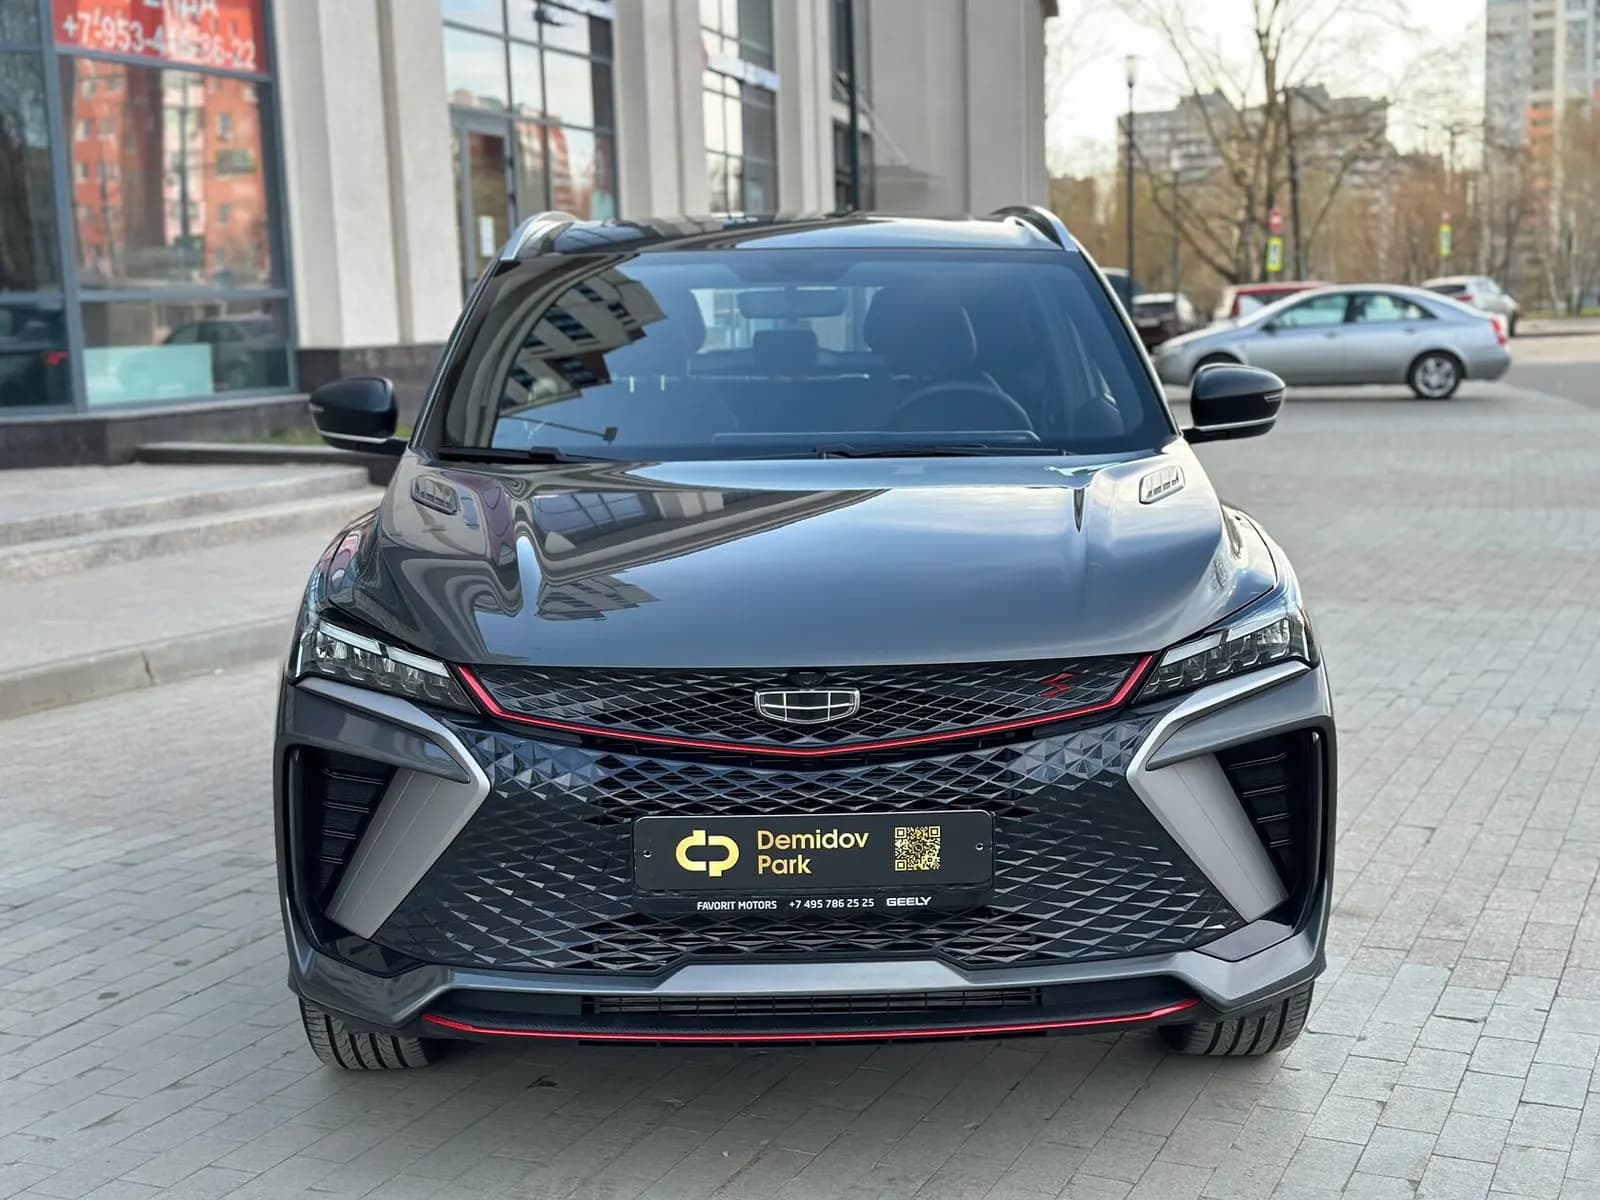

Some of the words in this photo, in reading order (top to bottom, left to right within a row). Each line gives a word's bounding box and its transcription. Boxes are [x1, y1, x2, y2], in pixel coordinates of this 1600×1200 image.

[757, 828, 870, 850] Demidov
[757, 854, 812, 875] Park
[697, 900, 736, 911] FAVORIT
[738, 900, 778, 910] MOTORS
[789, 900, 802, 909] +7
[804, 899, 823, 909] 495
[825, 899, 845, 909] 786
[847, 898, 860, 908] 25
[862, 898, 875, 908] 25
[886, 896, 932, 907] GEELY
